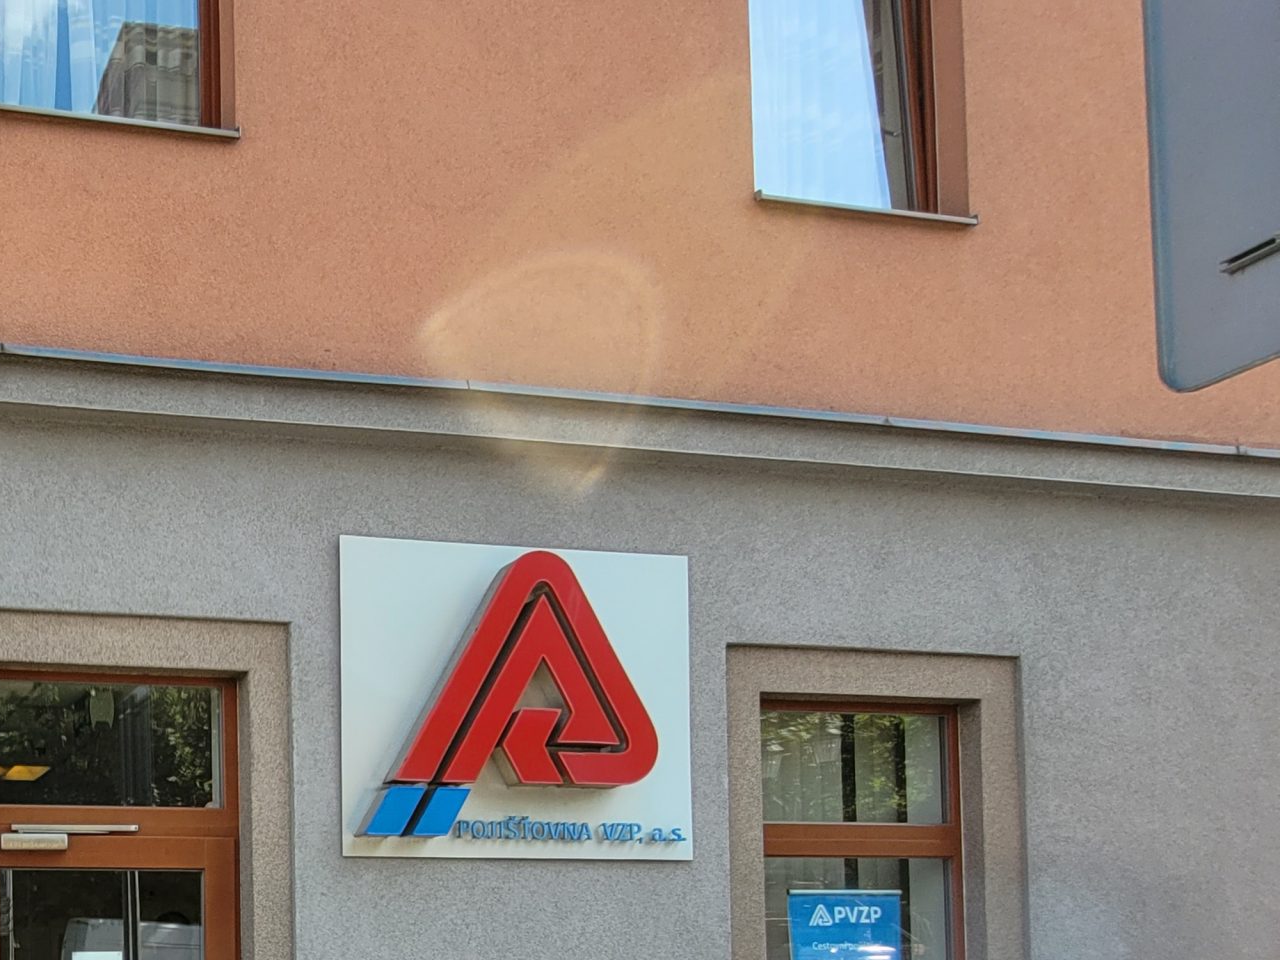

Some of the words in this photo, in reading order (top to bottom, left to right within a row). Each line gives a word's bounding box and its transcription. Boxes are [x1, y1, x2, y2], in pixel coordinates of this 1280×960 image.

[455, 815, 592, 841] POJIŠŤOVNA
[600, 822, 642, 844] VZP,
[650, 827, 687, 842] a.s.
[833, 906, 882, 924] PVZP
